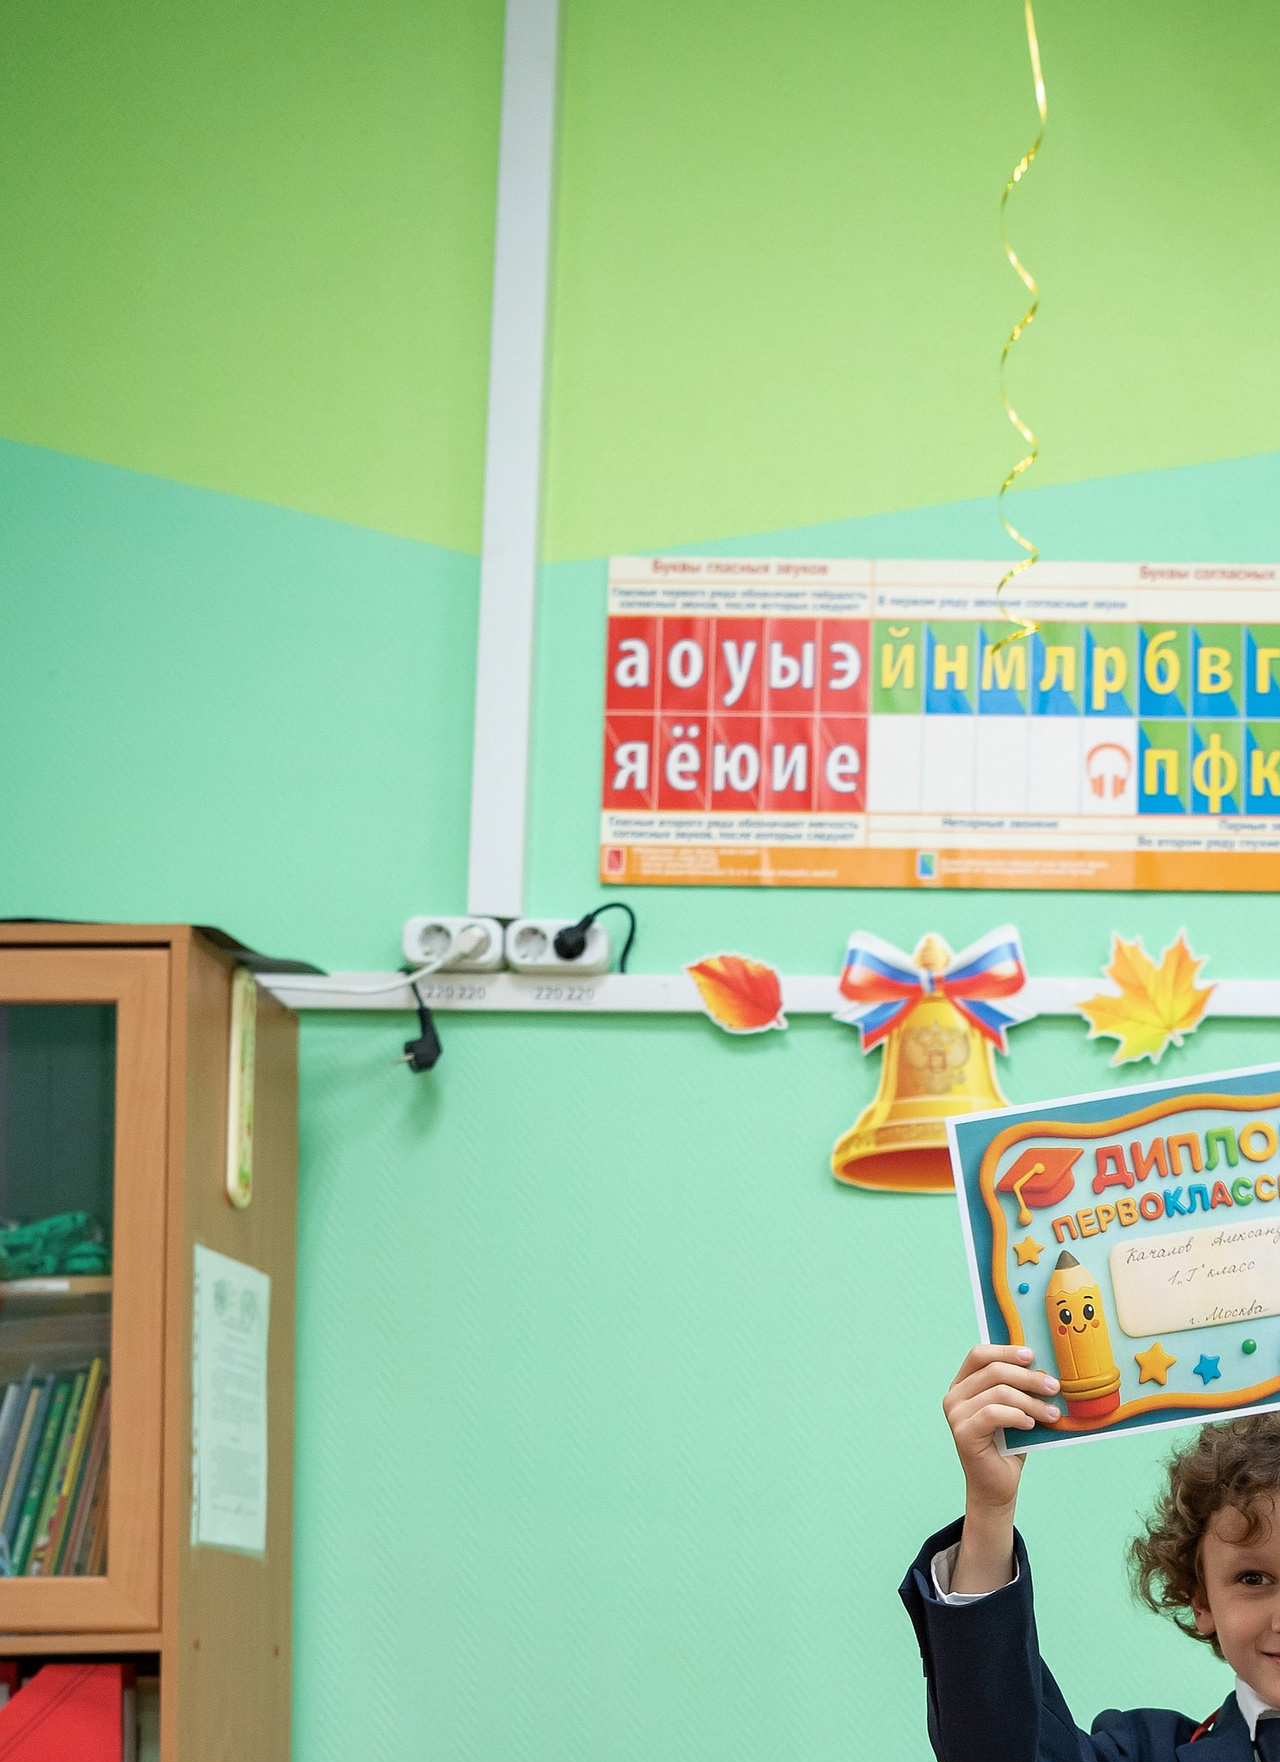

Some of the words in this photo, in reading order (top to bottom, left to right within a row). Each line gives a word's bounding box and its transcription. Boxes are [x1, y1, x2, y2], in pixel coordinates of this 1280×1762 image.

[615, 638, 650, 690] а
[667, 638, 703, 689] о
[723, 641, 757, 706] у
[770, 642, 814, 688] ы
[829, 642, 861, 690] э
[881, 626, 914, 689] й
[933, 643, 968, 690] н
[982, 644, 1026, 691] м
[1039, 645, 1076, 691] л
[1092, 644, 1127, 710] р
[1144, 630, 1179, 694] б
[1198, 648, 1233, 693] в
[1256, 648, 1280, 693] г
[612, 742, 649, 790] я
[667, 724, 700, 791] ё
[713, 743, 760, 792] ю
[772, 743, 808, 792] и
[826, 743, 860, 793] е
[1144, 749, 1178, 796] п
[1192, 733, 1238, 813] ф
[1205, 1299, 1269, 1322] Москва
